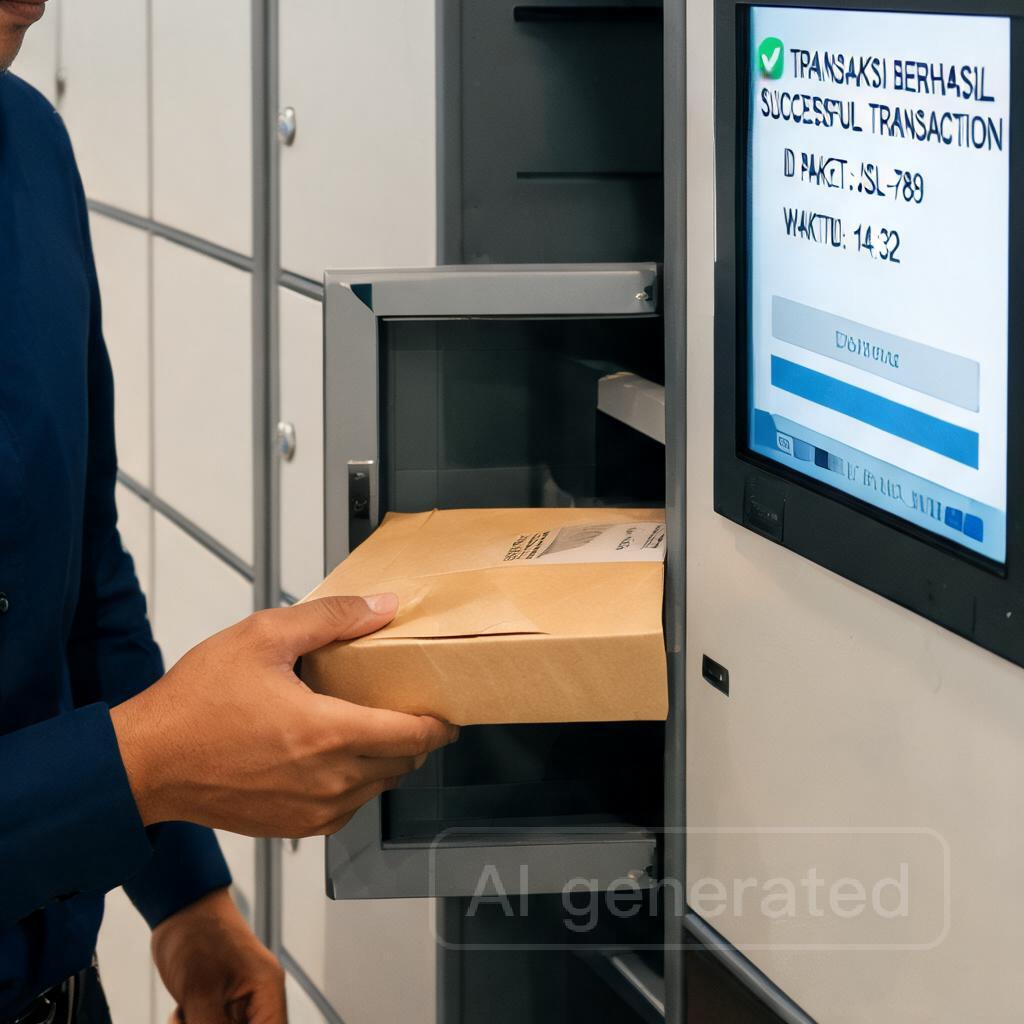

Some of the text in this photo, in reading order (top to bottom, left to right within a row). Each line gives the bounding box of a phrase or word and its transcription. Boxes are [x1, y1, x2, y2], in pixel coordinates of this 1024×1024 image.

[893, 59, 995, 102] BERHASIL
[761, 87, 1003, 151] SUCCESSFUL TRANSACTION
